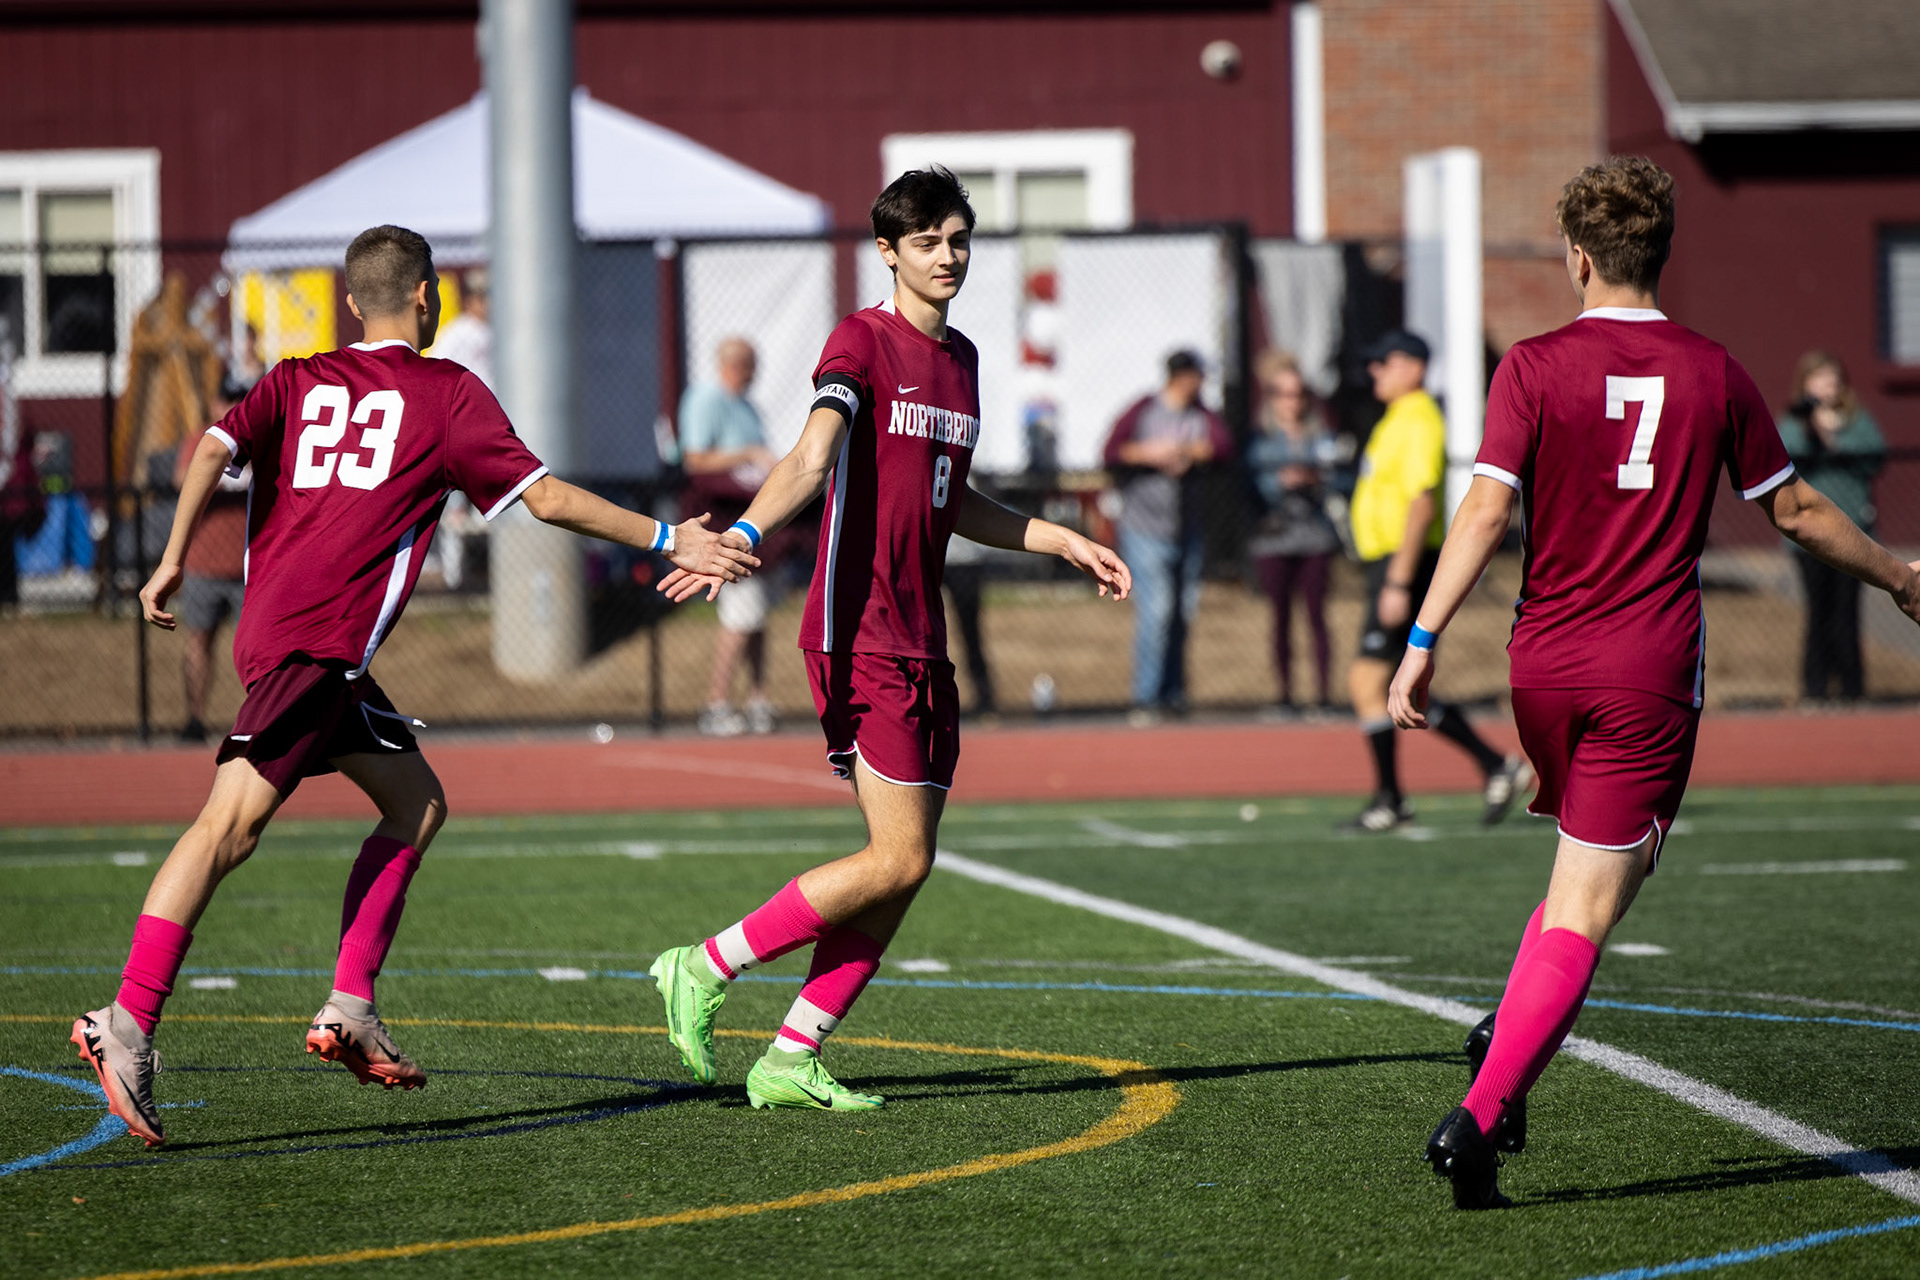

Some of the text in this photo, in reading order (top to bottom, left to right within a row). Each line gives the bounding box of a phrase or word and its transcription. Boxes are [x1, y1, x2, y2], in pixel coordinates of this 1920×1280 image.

[292, 384, 405, 491] 23
[932, 454, 952, 508] 8
[1605, 375, 1665, 489] 7
